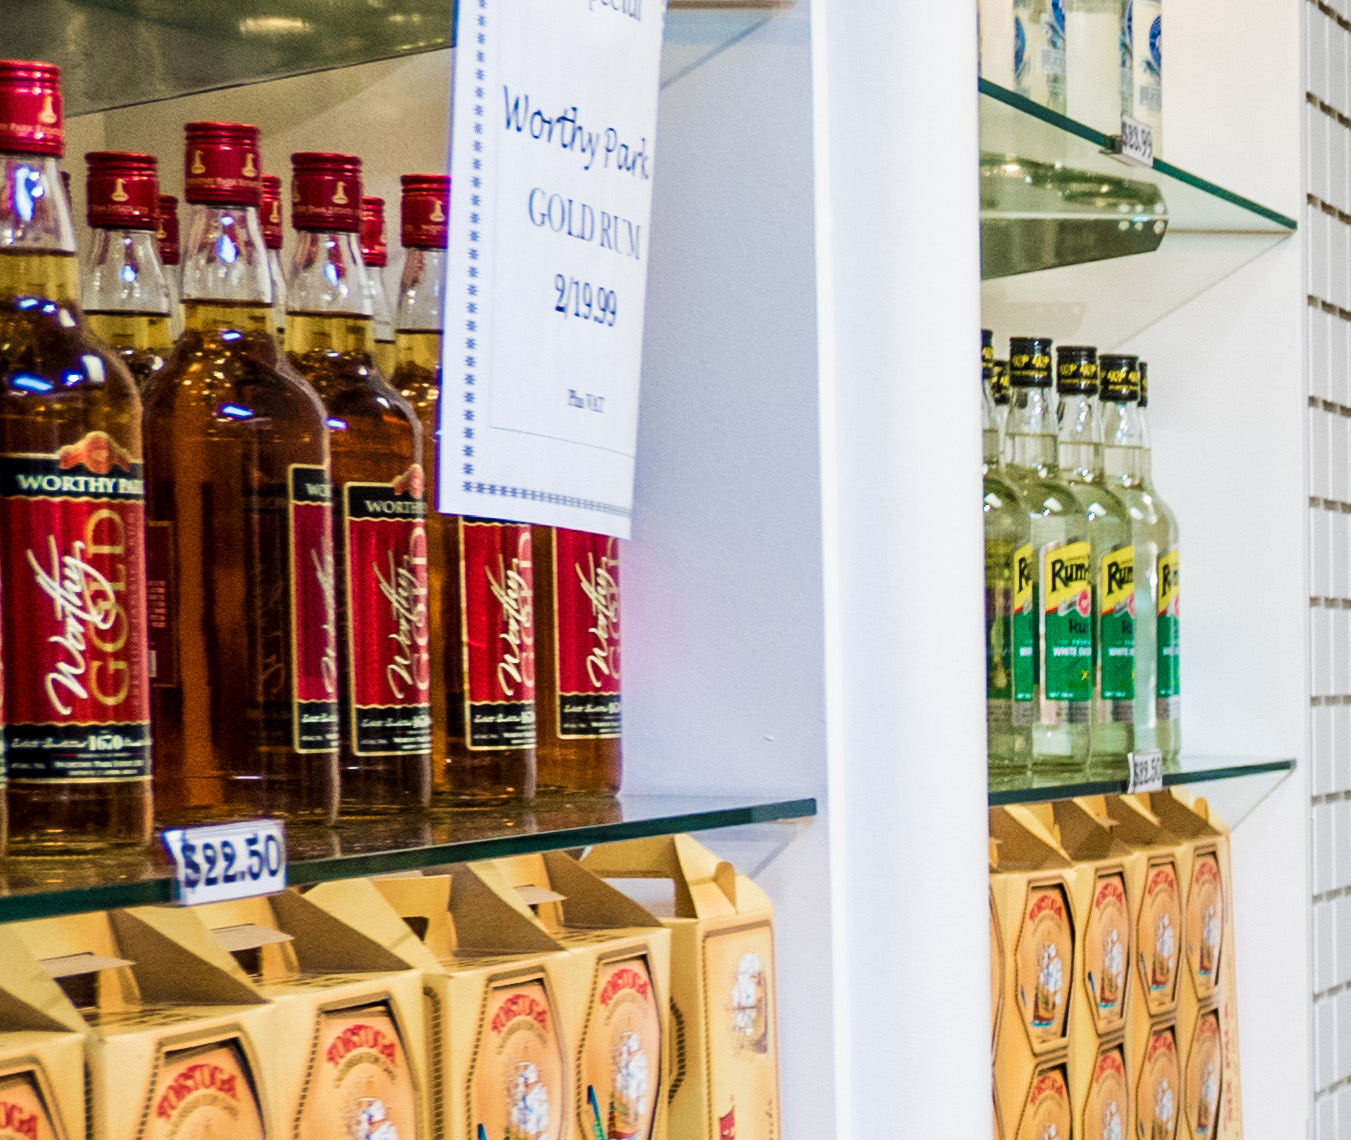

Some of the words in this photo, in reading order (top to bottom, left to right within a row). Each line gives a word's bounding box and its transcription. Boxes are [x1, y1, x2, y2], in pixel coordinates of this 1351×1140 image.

[502, 85, 600, 170] Worthy
[605, 127, 649, 179] Park
[528, 187, 595, 242] GOLD
[600, 211, 641, 260] RUM
[555, 273, 617, 327] 2/19.99
[18, 474, 117, 493] WORTHY
[364, 499, 426, 514] WORTH
[26, 534, 116, 716] Worthy
[181, 834, 280, 889] $22.50
